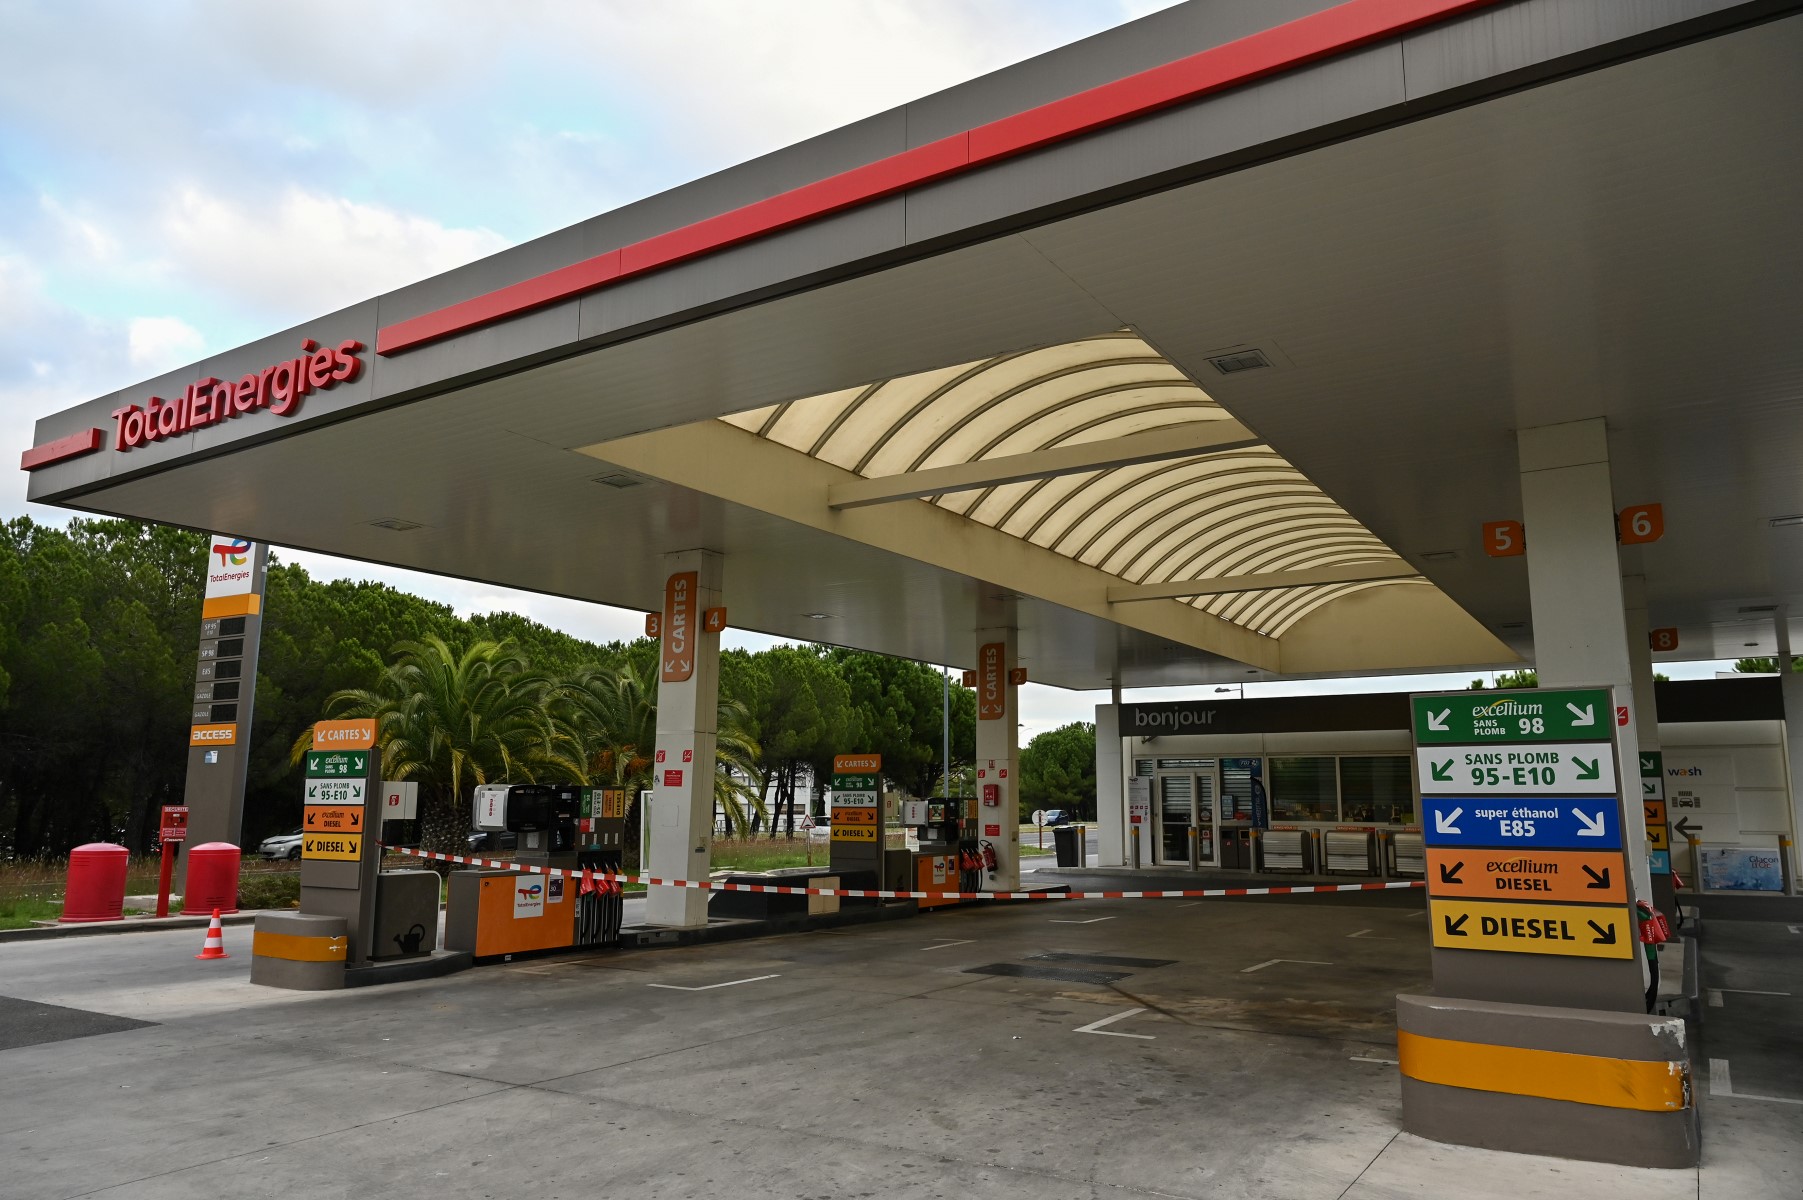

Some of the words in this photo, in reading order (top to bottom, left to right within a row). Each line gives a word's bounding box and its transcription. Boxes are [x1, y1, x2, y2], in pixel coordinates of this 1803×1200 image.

[112, 338, 363, 452] TotalEnergies
[1631, 511, 1652, 536] 6
[1495, 526, 1512, 550] 5
[210, 571, 250, 583] TotalEnergies
[671, 579, 687, 654] CARTES
[709, 611, 719, 628] 4
[650, 617, 658, 633] 3
[1658, 632, 1671, 648] 8
[966, 673, 972, 684] 1
[986, 648, 997, 700] CARTES
[1015, 671, 1022, 682] 2
[1472, 700, 1543, 718] excellium
[1135, 705, 1217, 731] bonjour
[1473, 719, 1498, 728] SANS
[1474, 727, 1506, 736] PLOMB
[1518, 717, 1545, 735] 98
[327, 728, 360, 741] CARTES
[1465, 753, 1503, 765] SANS
[1508, 752, 1560, 765] PLOMB
[338, 764, 348, 773] 98
[1471, 766, 1556, 786] 95-E10
[1667, 766, 1702, 776] wash
[321, 790, 348, 801] 95-E10
[1475, 809, 1509, 820] super
[1511, 807, 1559, 819] éthanol
[323, 820, 342, 828] DIESEL
[1500, 820, 1536, 837] E85
[842, 829, 865, 837] DIESEL
[316, 841, 345, 853] DIESEL
[1486, 858, 1559, 875] excellium
[1495, 877, 1552, 892] DIESEL
[1480, 915, 1576, 941] DIESEL
